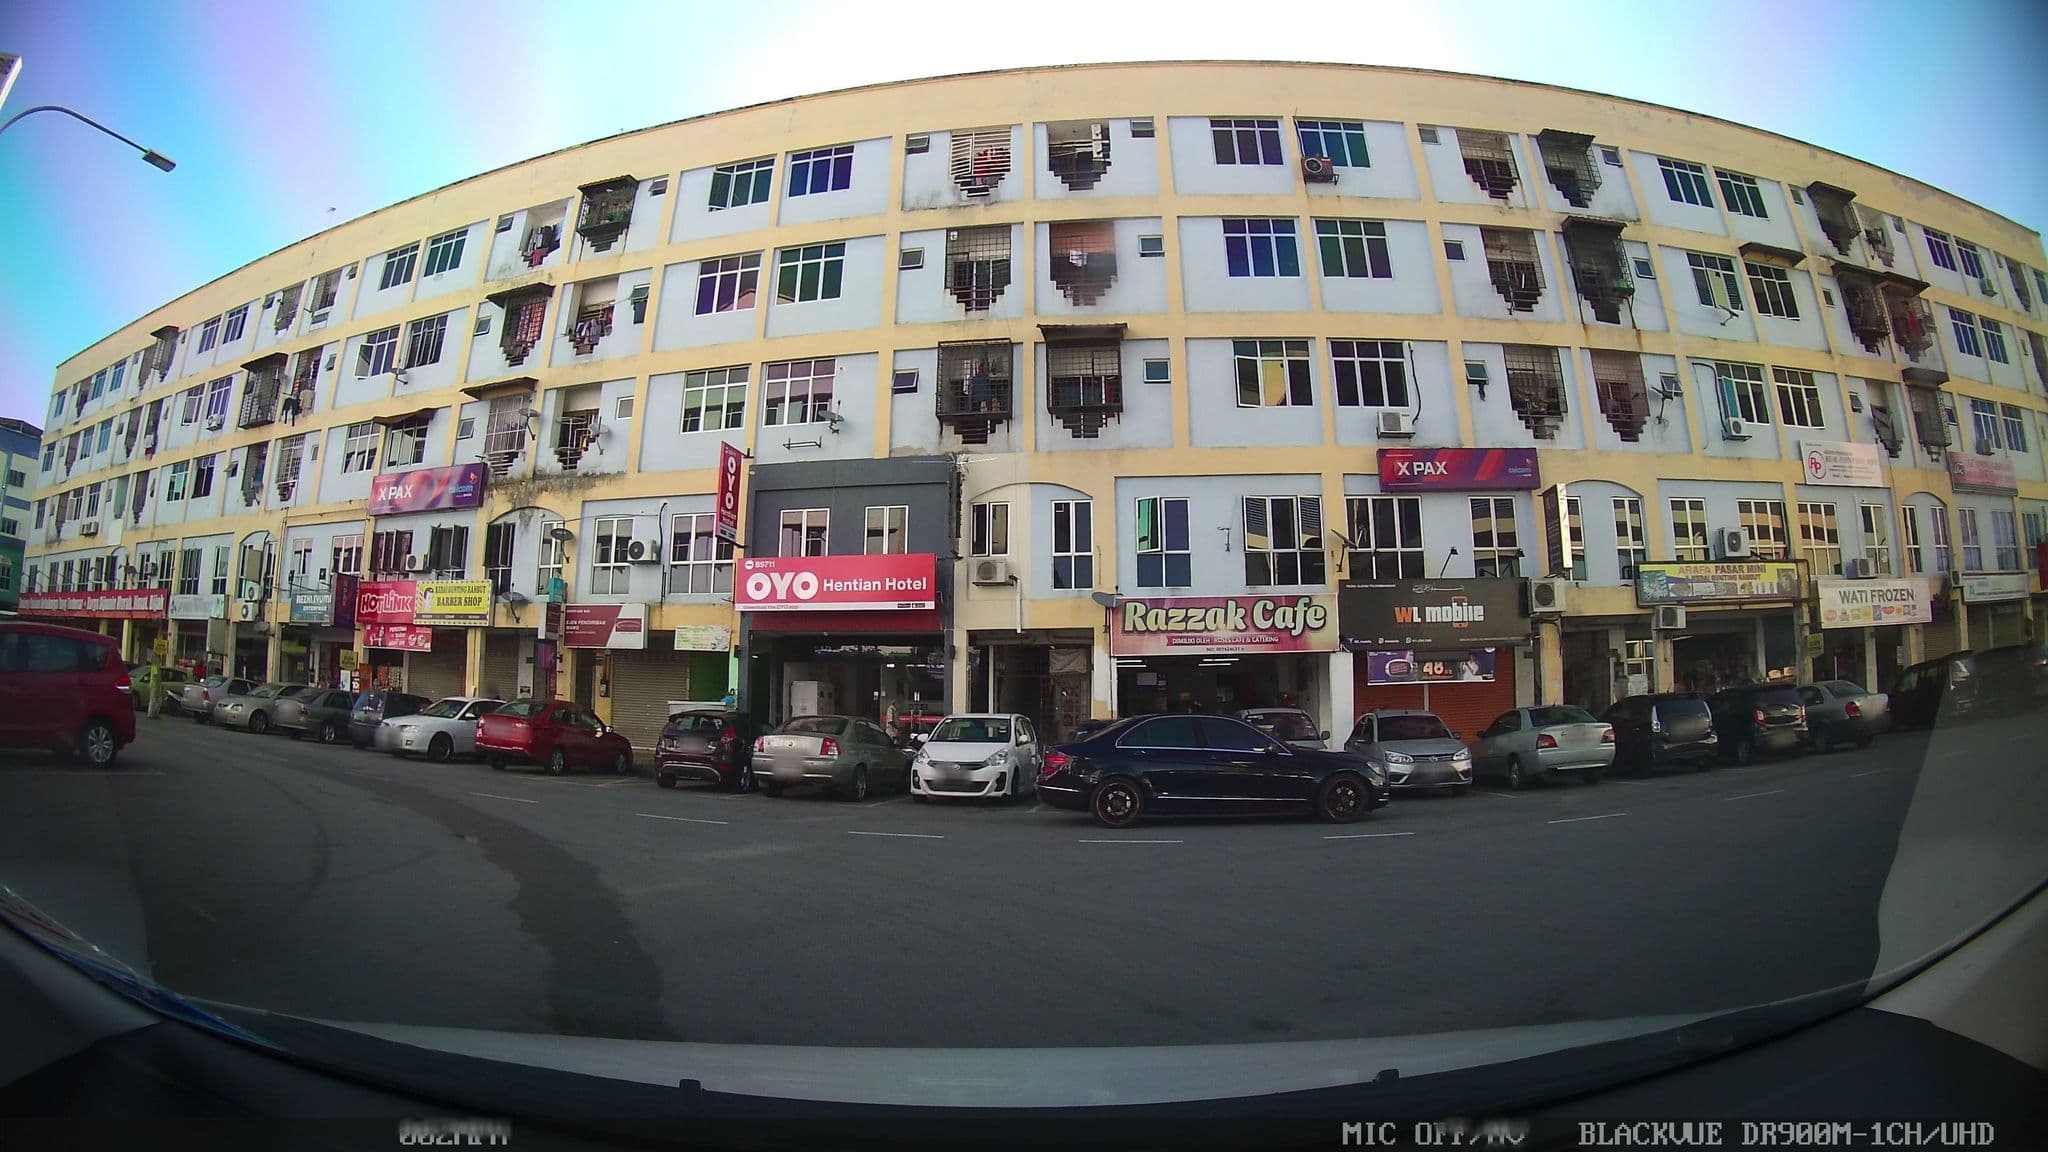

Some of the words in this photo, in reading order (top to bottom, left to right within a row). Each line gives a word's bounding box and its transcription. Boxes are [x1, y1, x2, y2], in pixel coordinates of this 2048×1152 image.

[1396, 461, 1411, 476] X
[1412, 461, 1449, 476] PAX
[725, 456, 737, 510] OYO
[377, 487, 387, 501] X
[388, 485, 414, 500] PAX
[1714, 565, 1745, 575] PASAR
[1746, 564, 1767, 574] MINI
[746, 571, 819, 600] OYO
[823, 578, 881, 592] Hentian
[885, 577, 927, 591] Hotel
[436, 597, 462, 607] BARBER
[463, 596, 483, 607] SHOP
[1839, 589, 1868, 604] WATI
[1870, 588, 1916, 603] FROZEN
[1124, 600, 1247, 632] Razzak
[1252, 597, 1327, 637] Cafe
[1395, 606, 1422, 623] WL
[1425, 602, 1484, 623] mobile
